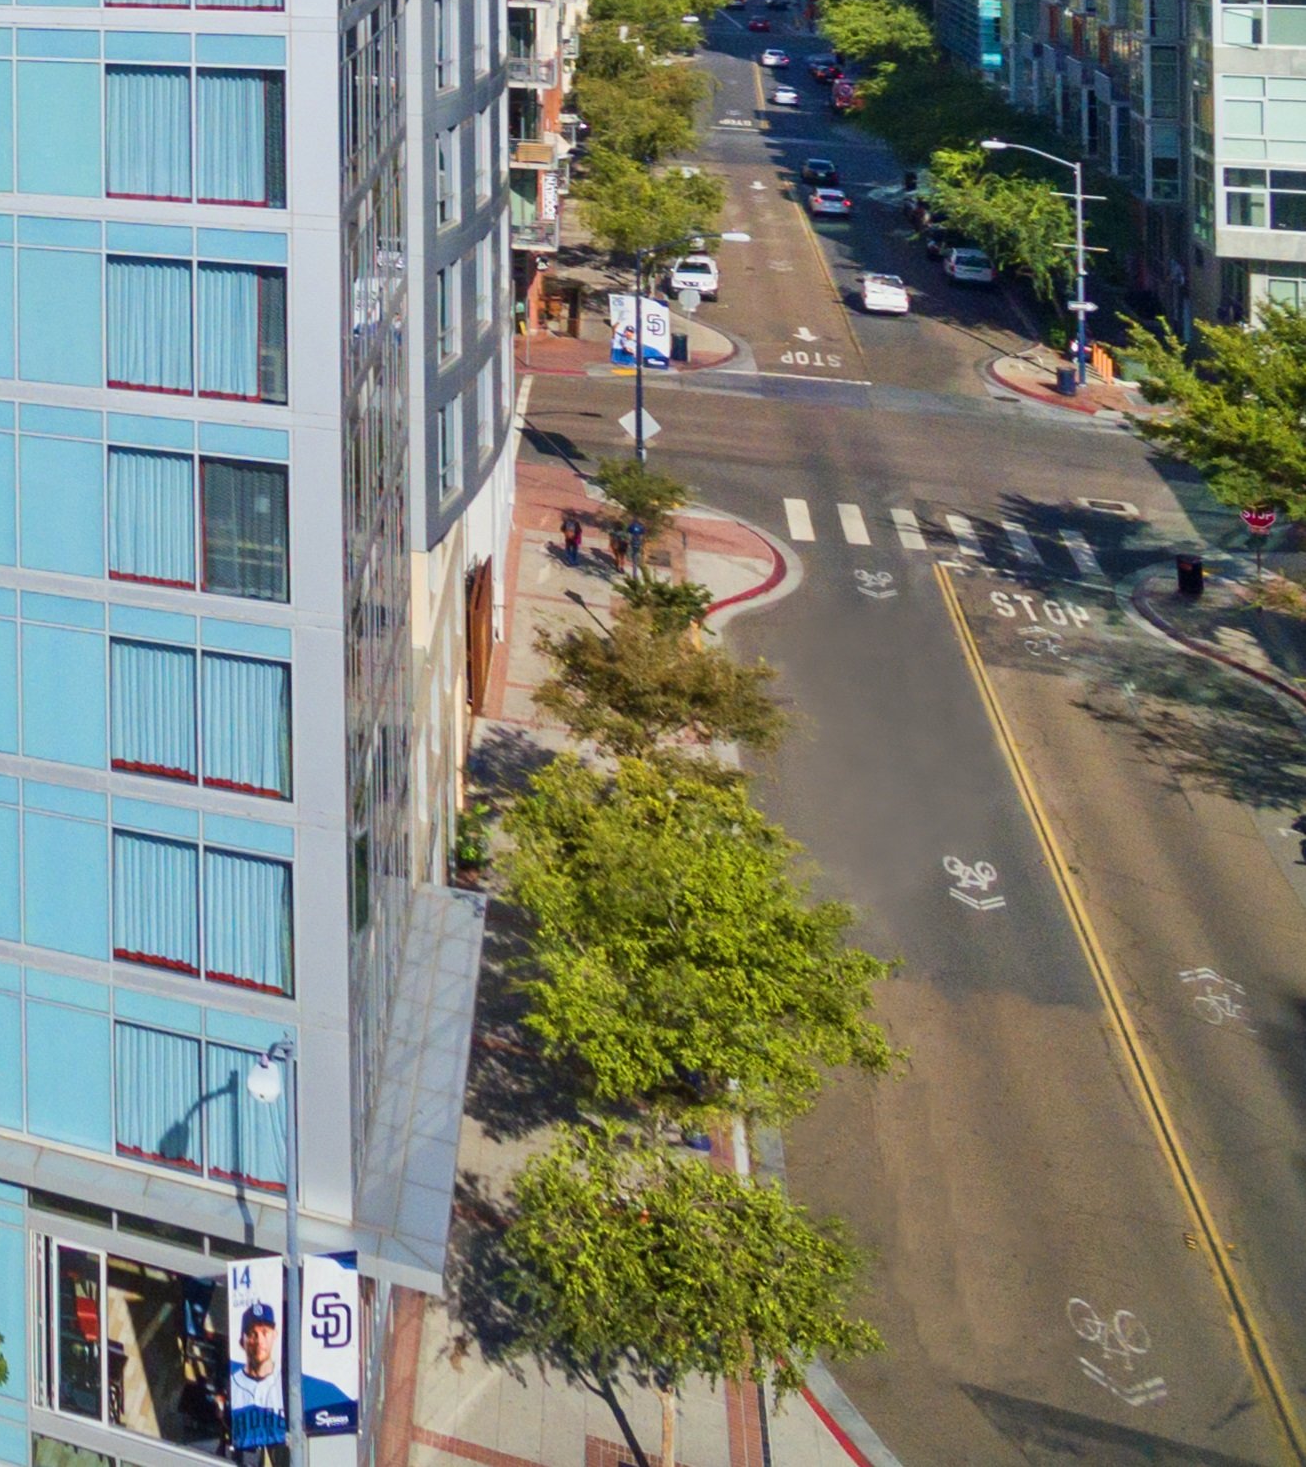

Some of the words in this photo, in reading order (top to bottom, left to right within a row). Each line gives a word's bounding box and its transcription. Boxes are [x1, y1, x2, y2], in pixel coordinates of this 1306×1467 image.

[780, 350, 842, 368] STOP
[990, 590, 1091, 629] STOP
[232, 1265, 251, 1291] 14
[311, 1292, 352, 1349] SD
